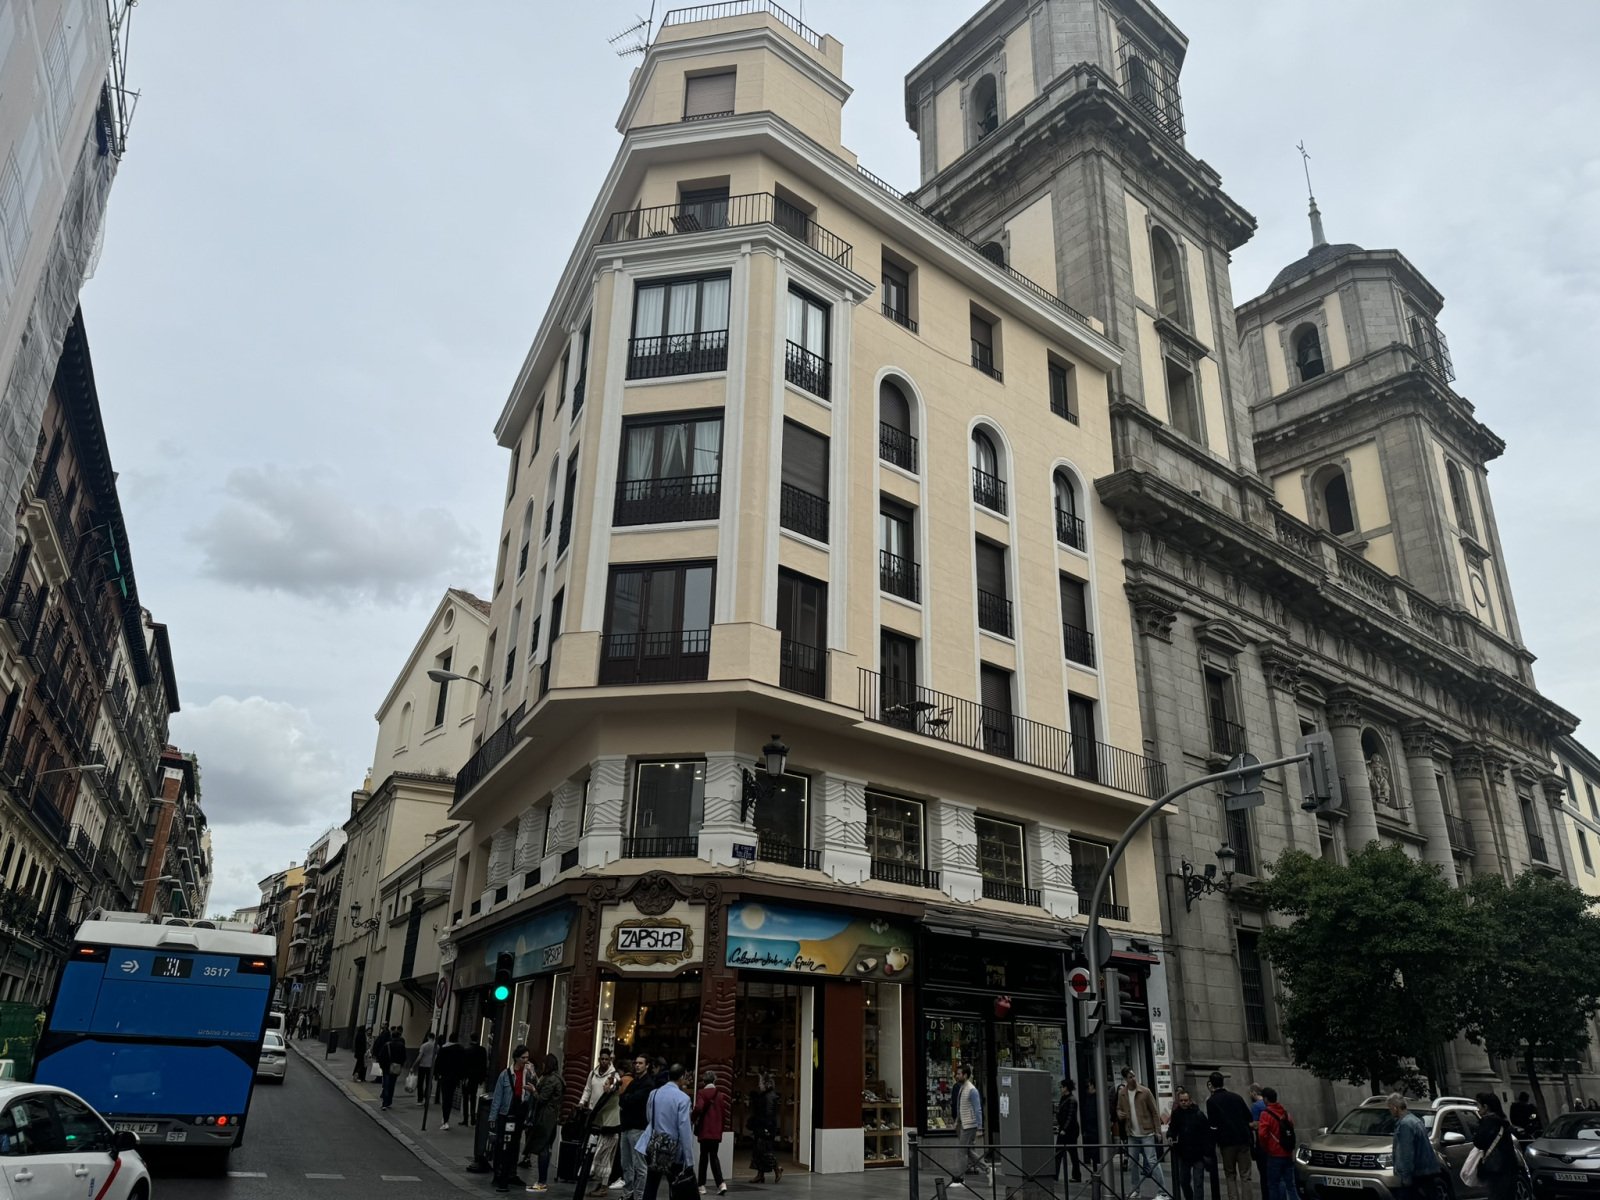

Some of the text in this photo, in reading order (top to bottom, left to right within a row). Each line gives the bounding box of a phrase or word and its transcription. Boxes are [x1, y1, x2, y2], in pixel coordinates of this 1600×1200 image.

[620, 929, 681, 948] ZAPSHOP
[203, 966, 231, 978] 3517
[1152, 1007, 1161, 1017] 35
[169, 1132, 185, 1141] SP
[1328, 1177, 1345, 1186] 7429
